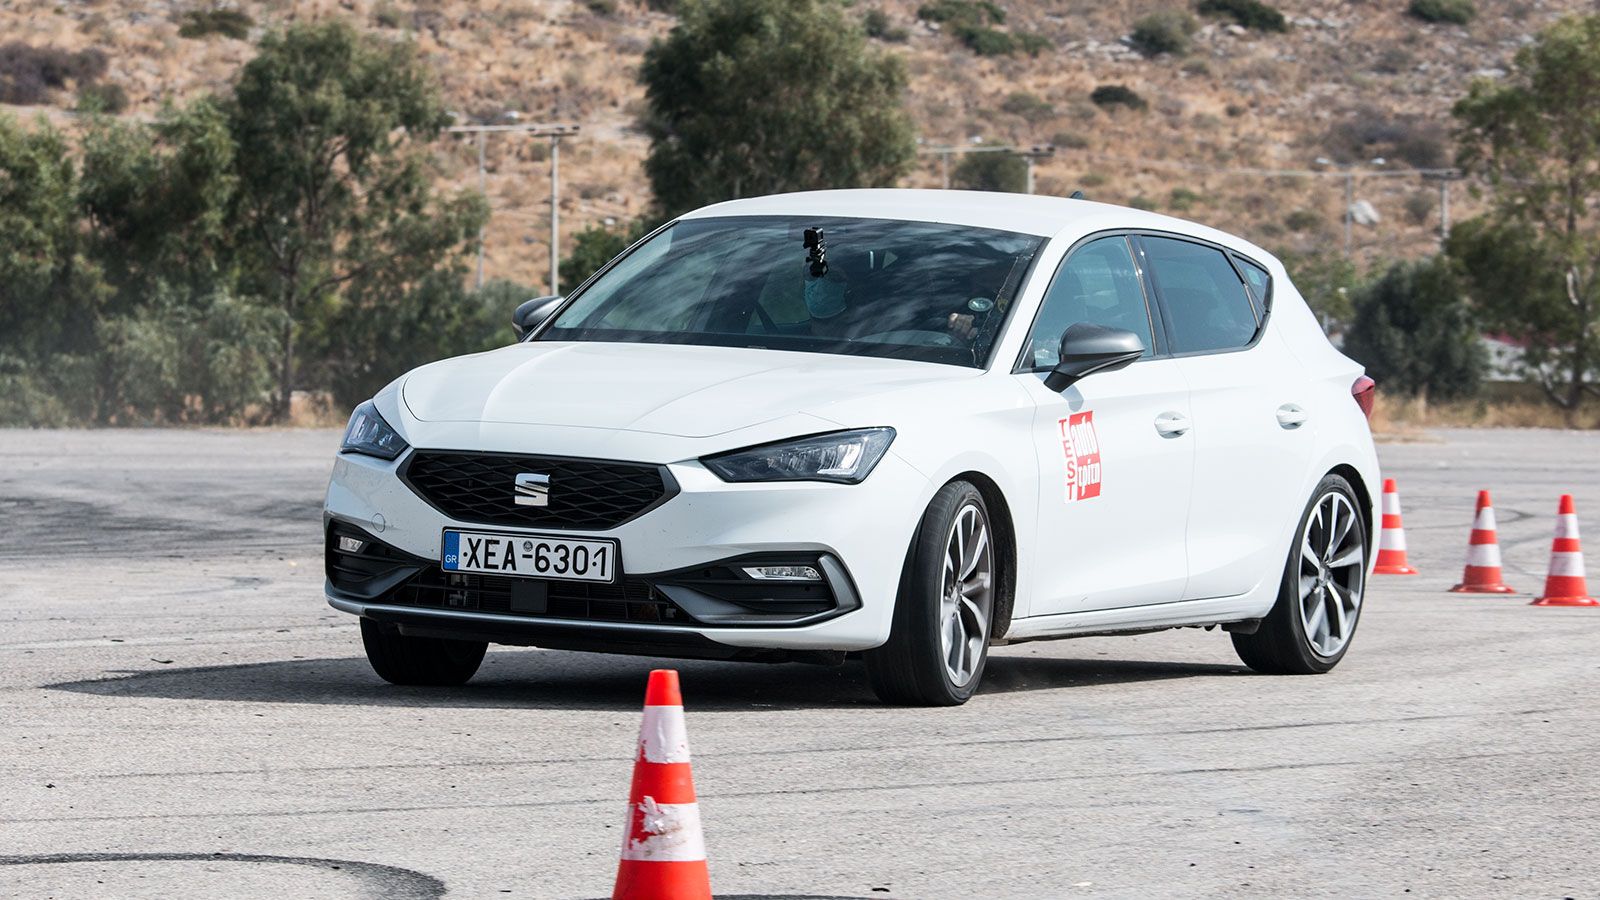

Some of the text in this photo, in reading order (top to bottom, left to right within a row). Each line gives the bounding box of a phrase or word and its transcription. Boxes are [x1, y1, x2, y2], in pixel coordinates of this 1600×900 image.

[1058, 419, 1076, 500] TEST
[445, 554, 457, 564] GR
[465, 537, 607, 577] XEA-6301
